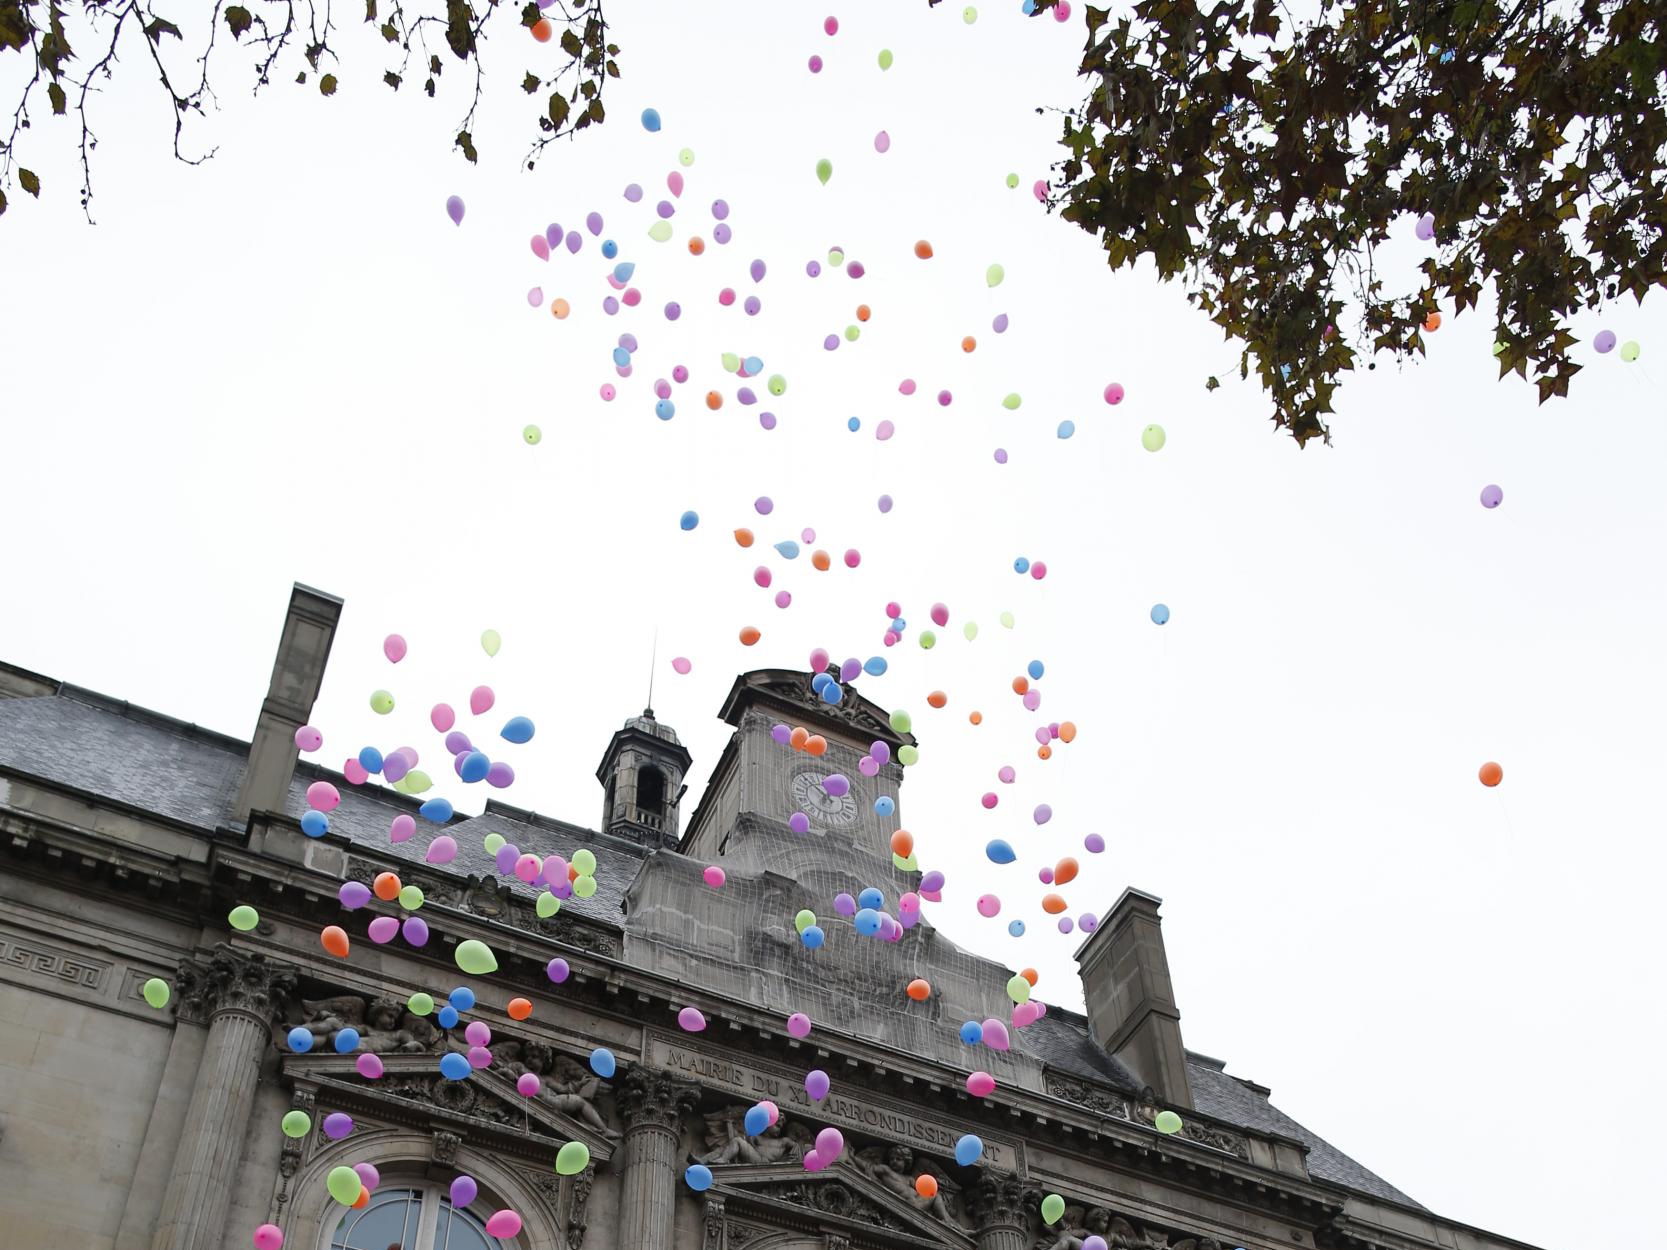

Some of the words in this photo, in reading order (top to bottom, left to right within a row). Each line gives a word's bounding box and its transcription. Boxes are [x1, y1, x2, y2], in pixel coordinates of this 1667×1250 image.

[667, 1050, 744, 1086] MAIRIE
[752, 1074, 781, 1097] DU
[822, 1096, 1001, 1162] ARRONDISSET
